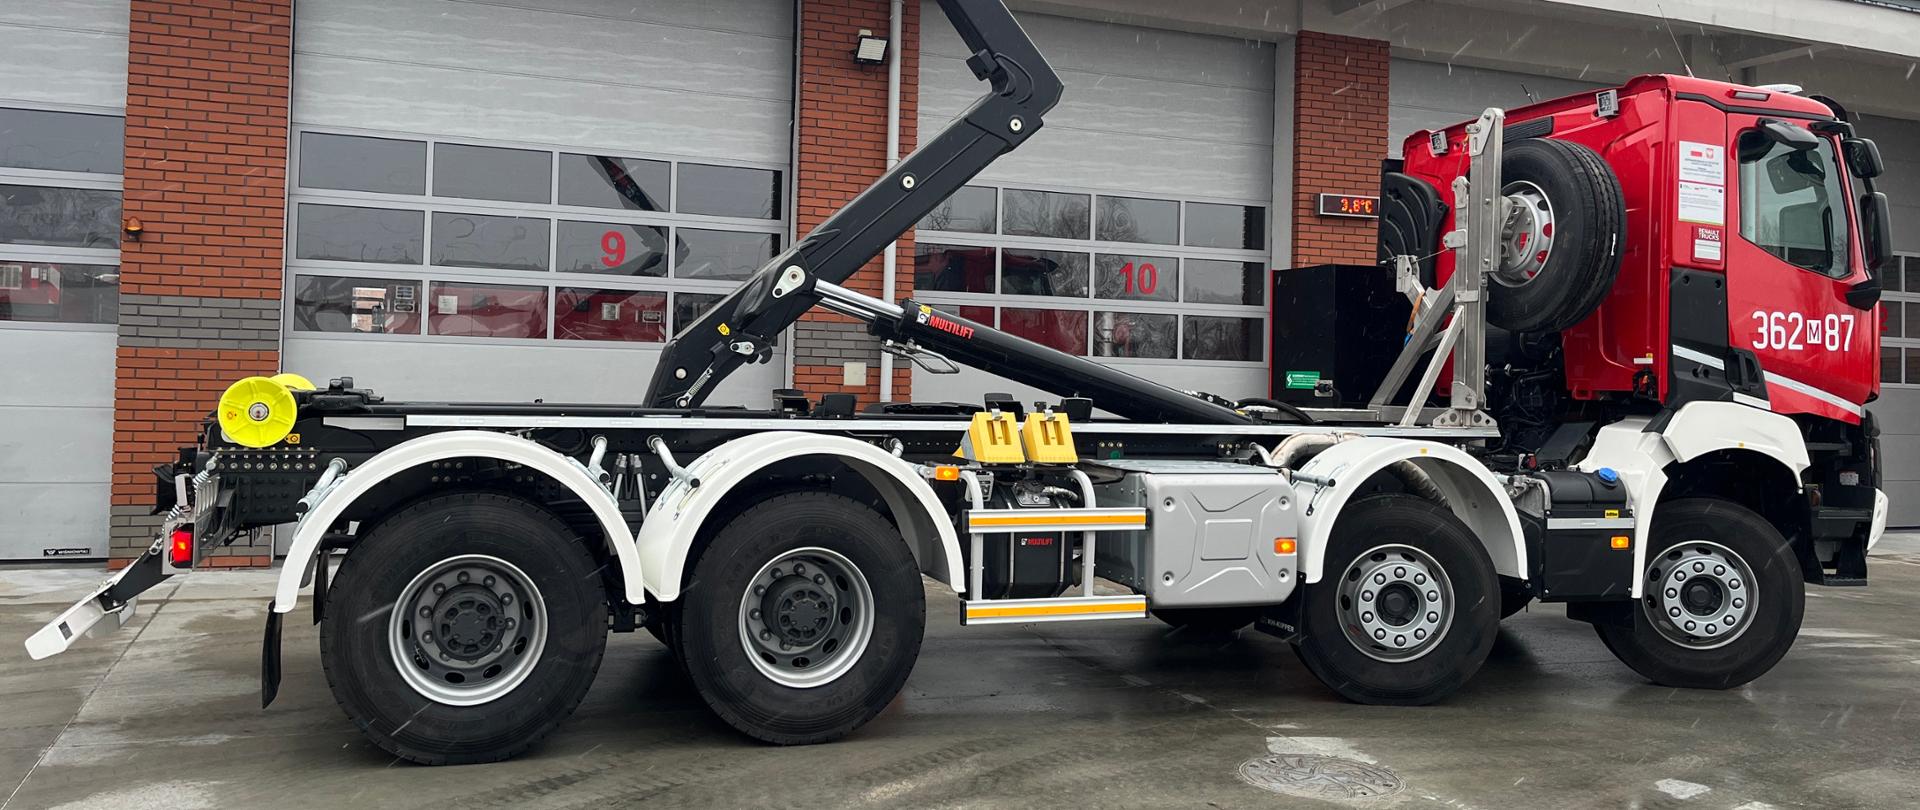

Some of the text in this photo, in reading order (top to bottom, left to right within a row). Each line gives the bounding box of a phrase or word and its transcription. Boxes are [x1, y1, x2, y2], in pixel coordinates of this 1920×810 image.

[601, 230, 626, 268] 9
[1120, 261, 1157, 295] 10
[929, 315, 975, 340] MULTILIFT
[1752, 310, 1855, 352] 362 M 87
